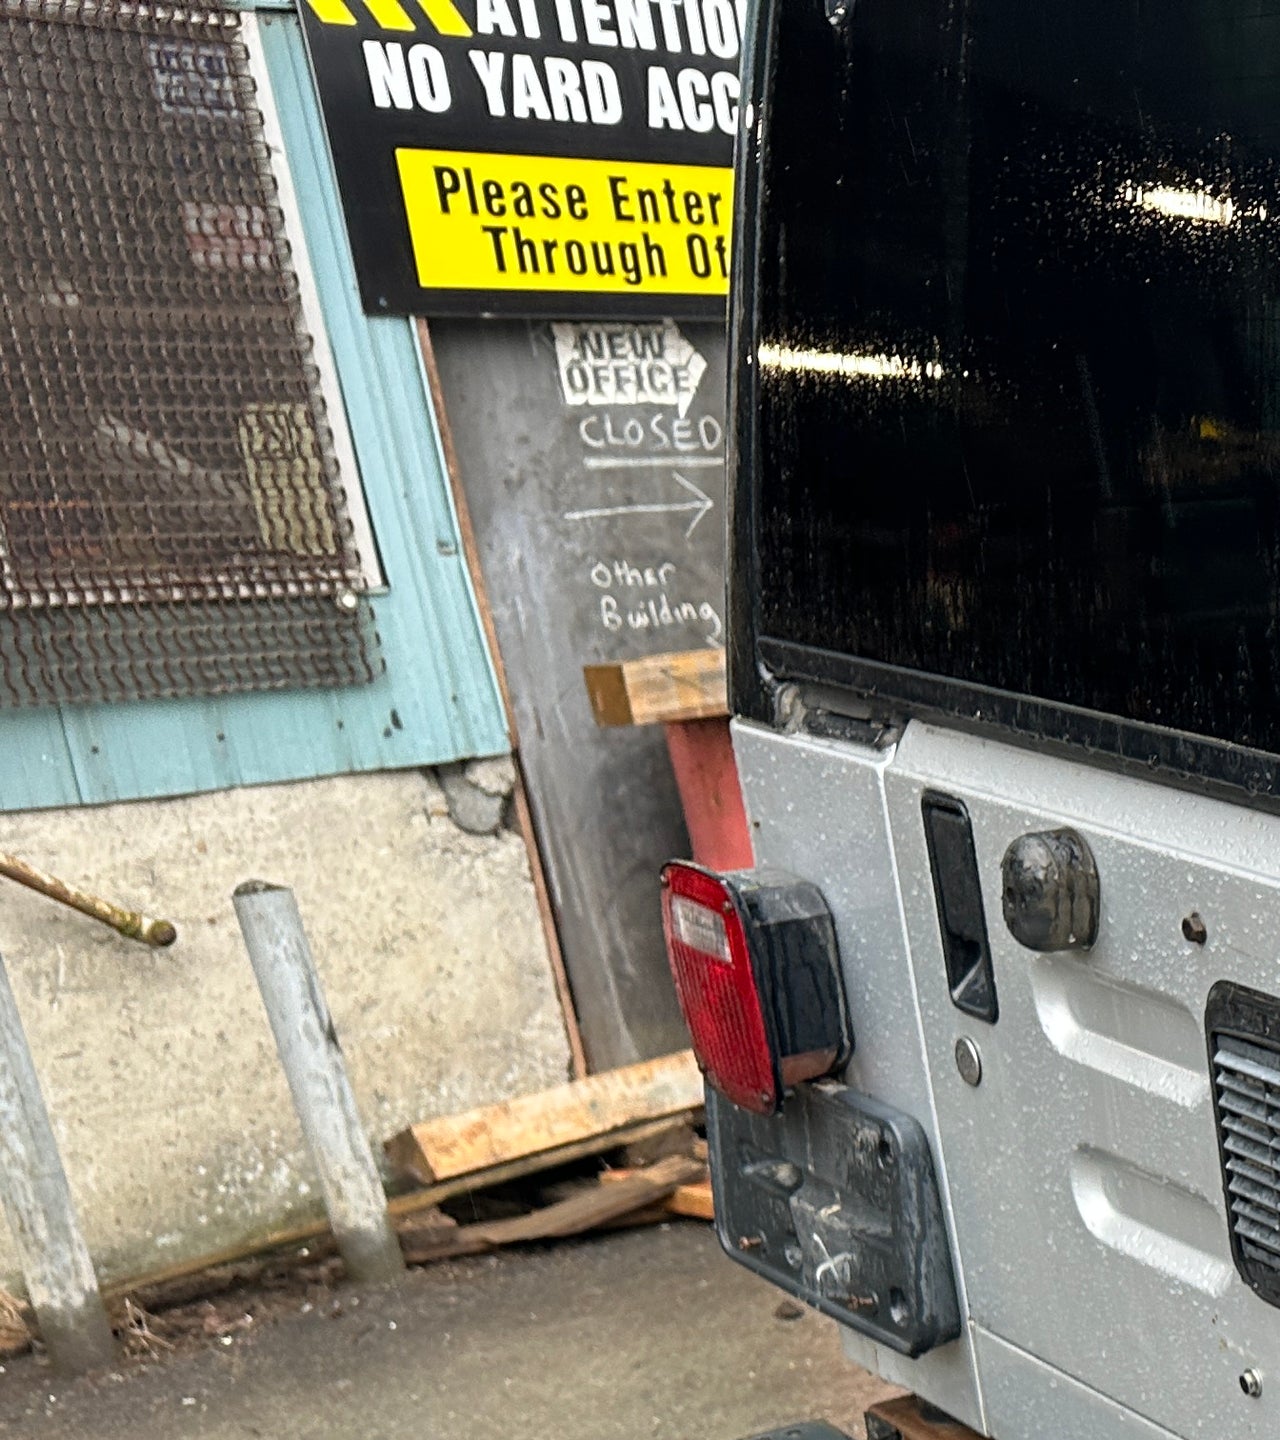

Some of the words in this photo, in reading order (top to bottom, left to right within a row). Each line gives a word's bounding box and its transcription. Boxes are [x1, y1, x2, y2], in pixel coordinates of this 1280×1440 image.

[476, 0, 747, 59] ATTENTIO
[362, 39, 452, 114] NO
[468, 50, 622, 126] YARD
[433, 166, 589, 220] Please
[608, 176, 722, 227] Enter
[482, 225, 667, 285] Through
[580, 329, 664, 361] NEW
[565, 359, 692, 395] OFFICE
[579, 414, 723, 451] CLOSED
[590, 560, 676, 588] Other
[601, 595, 722, 650] Building
